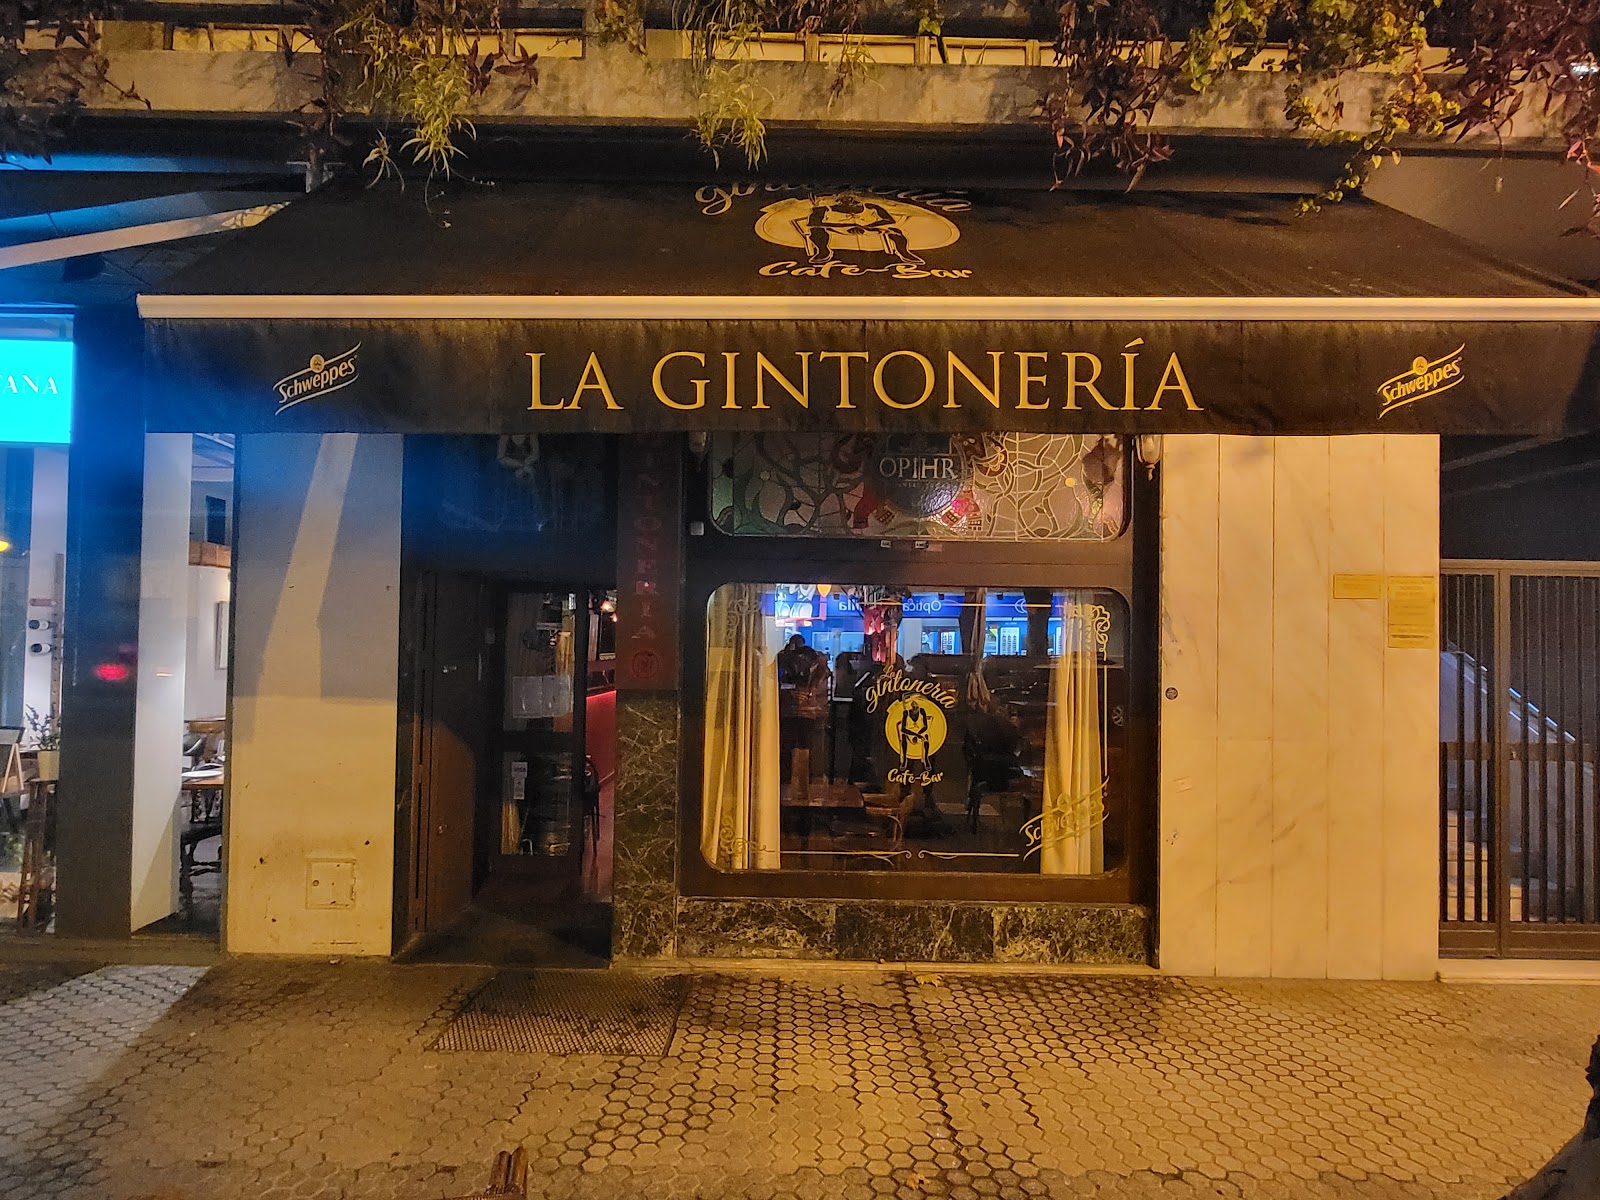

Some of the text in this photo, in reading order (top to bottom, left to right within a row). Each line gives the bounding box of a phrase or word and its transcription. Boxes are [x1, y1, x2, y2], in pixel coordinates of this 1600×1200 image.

[0, 374, 59, 394] ANA
[278, 356, 357, 404] Schweppes
[525, 337, 1205, 411] LA GINTONERÍA
[1381, 358, 1462, 406] Schweppes
[879, 456, 959, 481] OPIHR
